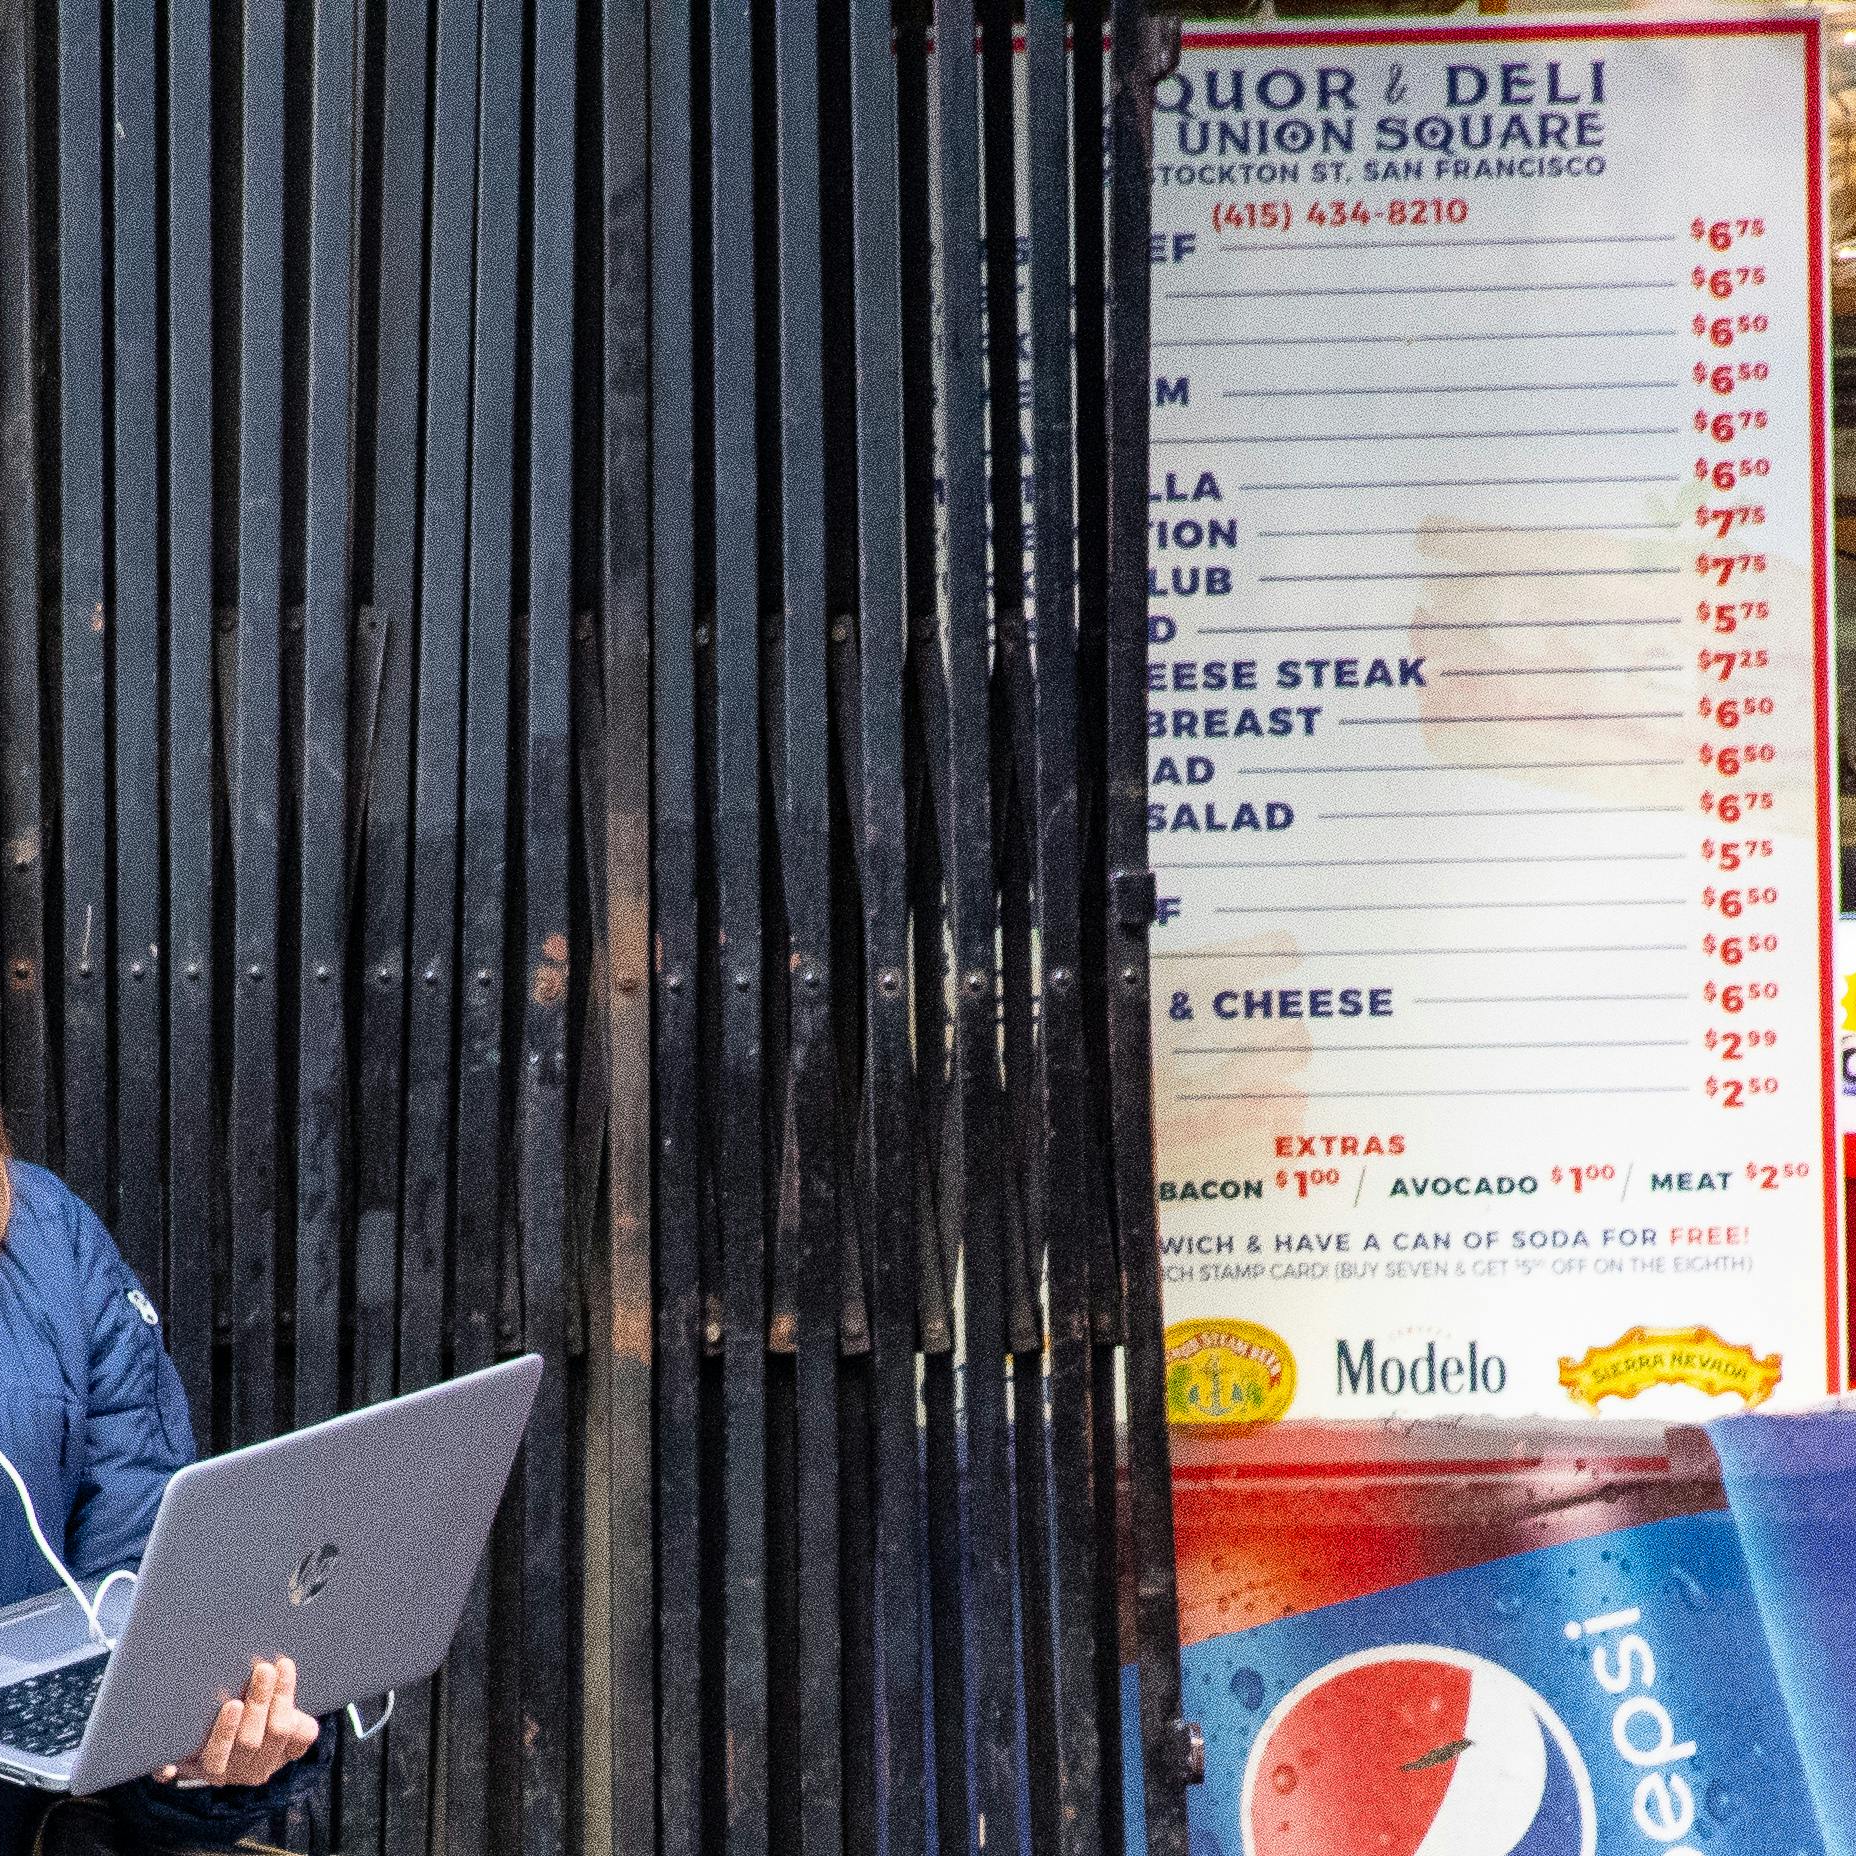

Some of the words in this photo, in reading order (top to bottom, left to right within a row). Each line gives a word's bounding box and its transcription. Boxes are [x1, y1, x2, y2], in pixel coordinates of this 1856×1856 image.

[1154, 66, 1359, 118] QUOR
[1445, 58, 1606, 106] DELI
[1177, 116, 1355, 155] UNION
[1375, 112, 1602, 157] SQUARE
[1153, 162, 1299, 187] TOCKTON
[1363, 159, 1423, 182] SAN
[1434, 154, 1607, 180] FRANCISCO
[1211, 201, 1293, 232] (415)
[1306, 197, 1470, 228] 434-8210
[1148, 471, 1223, 501] LA
[1149, 519, 1238, 550] ION
[1276, 656, 1427, 690] STEAK
[1148, 706, 1323, 738] BREAST
[1147, 801, 1295, 832] SALAD
[1168, 990, 1194, 1022] &
[1211, 988, 1393, 1021] CHEESE
[1272, 1133, 1405, 1159] EXTRAS
[1159, 1180, 1264, 1202] BACON
[1389, 1175, 1539, 1198] AVOCADO
[1650, 1171, 1732, 1192] MEAT
[1246, 1234, 1262, 1254] &
[1274, 1233, 1348, 1253] HAVE
[1362, 1232, 1381, 1252] A
[1392, 1232, 1451, 1252] CAN
[1462, 1230, 1497, 1251] OF
[1511, 1229, 1589, 1250] SODA
[1601, 1227, 1658, 1247] FOR
[1668, 1225, 1749, 1246] FREE!
[1336, 1338, 1507, 1395] Modelo
